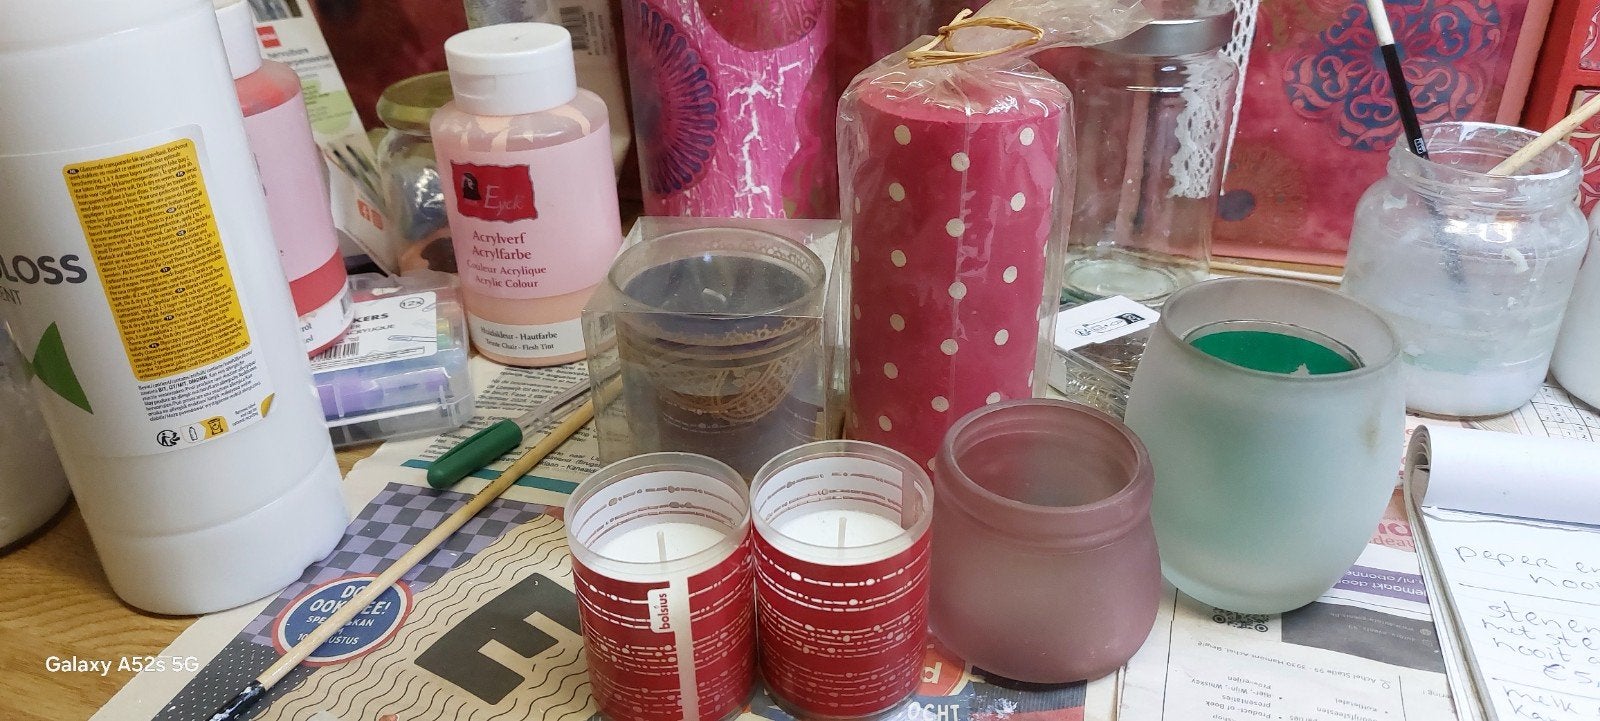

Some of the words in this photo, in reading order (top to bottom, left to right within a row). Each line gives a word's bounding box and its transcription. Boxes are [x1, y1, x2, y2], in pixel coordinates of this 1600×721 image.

[473, 230, 526, 246] Acrylverf
[472, 246, 532, 260] Acrylfarbe
[0, 254, 88, 284] LOSS
[467, 259, 497, 273] Couleur
[500, 266, 547, 277] Acrylique
[476, 275, 502, 287] Acrylic
[505, 279, 539, 288] Colour
[520, 332, 558, 340] Hautfarbe
[658, 593, 670, 630] bolsius
[1205, 701, 1224, 709] Boek
[1222, 695, 1271, 708] presentaties
